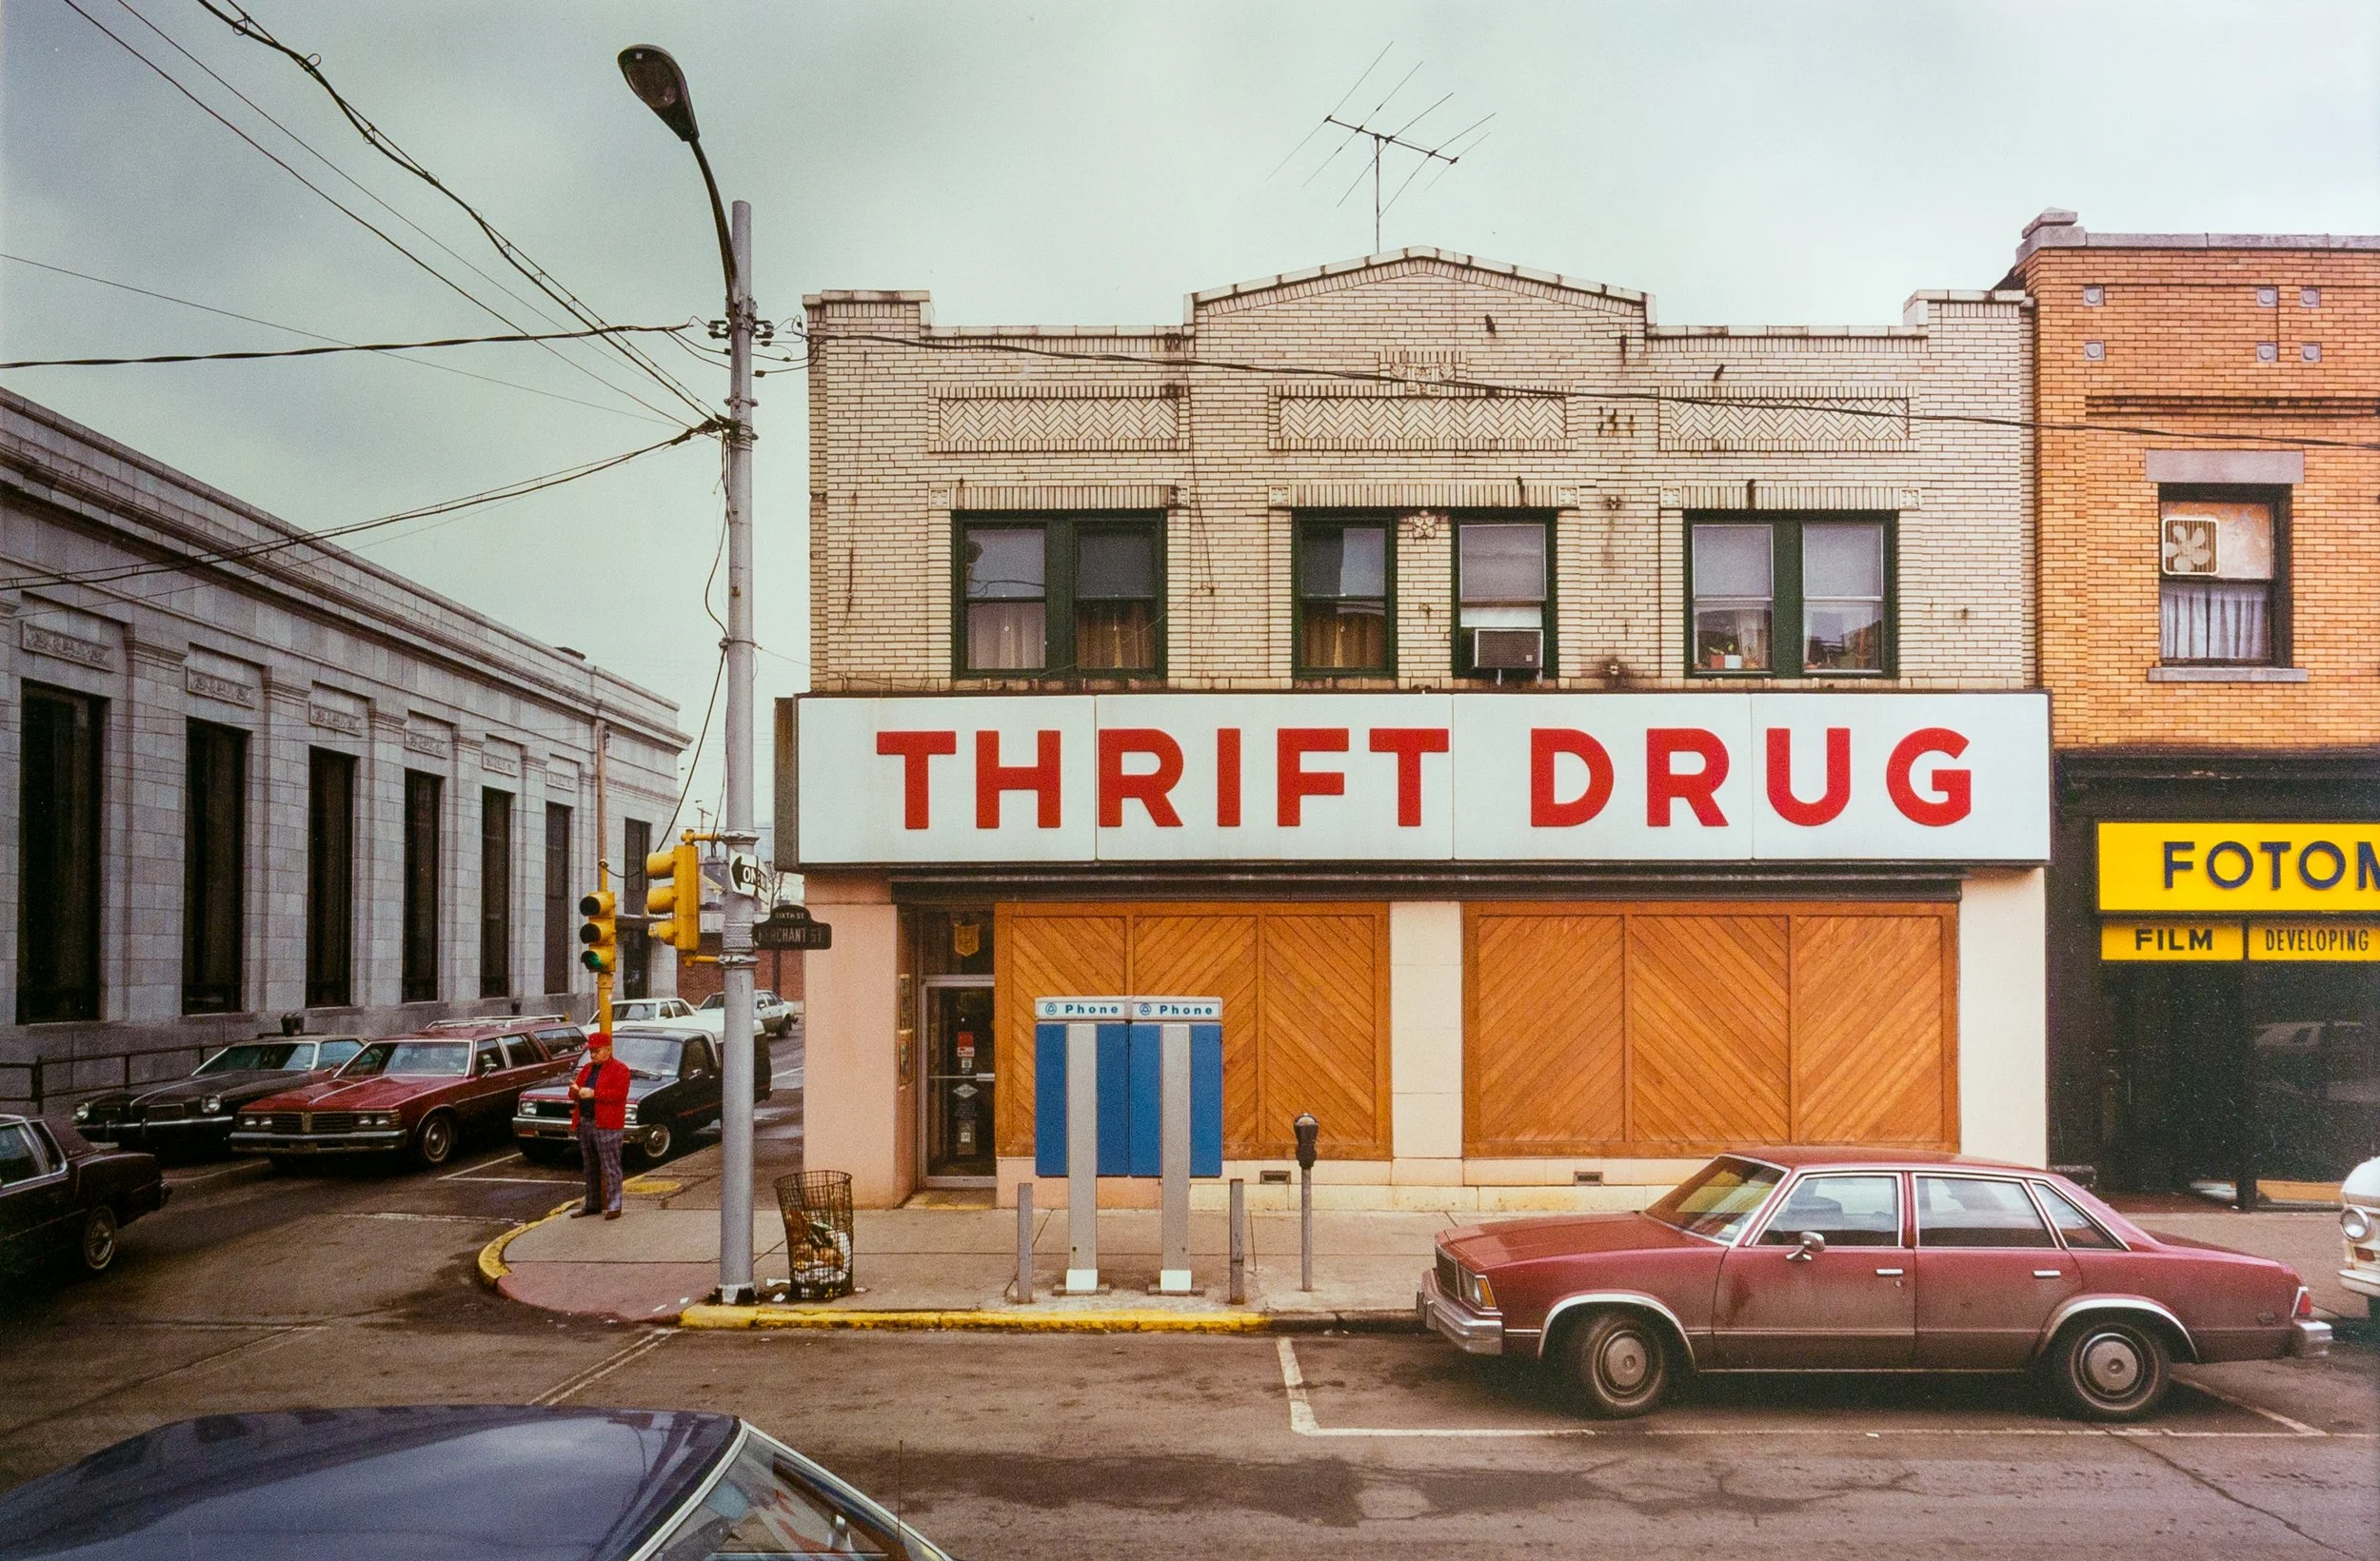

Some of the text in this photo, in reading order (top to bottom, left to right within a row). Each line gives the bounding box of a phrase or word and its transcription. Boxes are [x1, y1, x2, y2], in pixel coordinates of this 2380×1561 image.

[878, 727, 1972, 828] THRIFT DRUG
[2135, 929, 2212, 951] FILM
[2266, 929, 2369, 952] DEVELOPING
[1064, 1004, 1119, 1014] Phone
[1160, 1004, 1213, 1015] Phone
